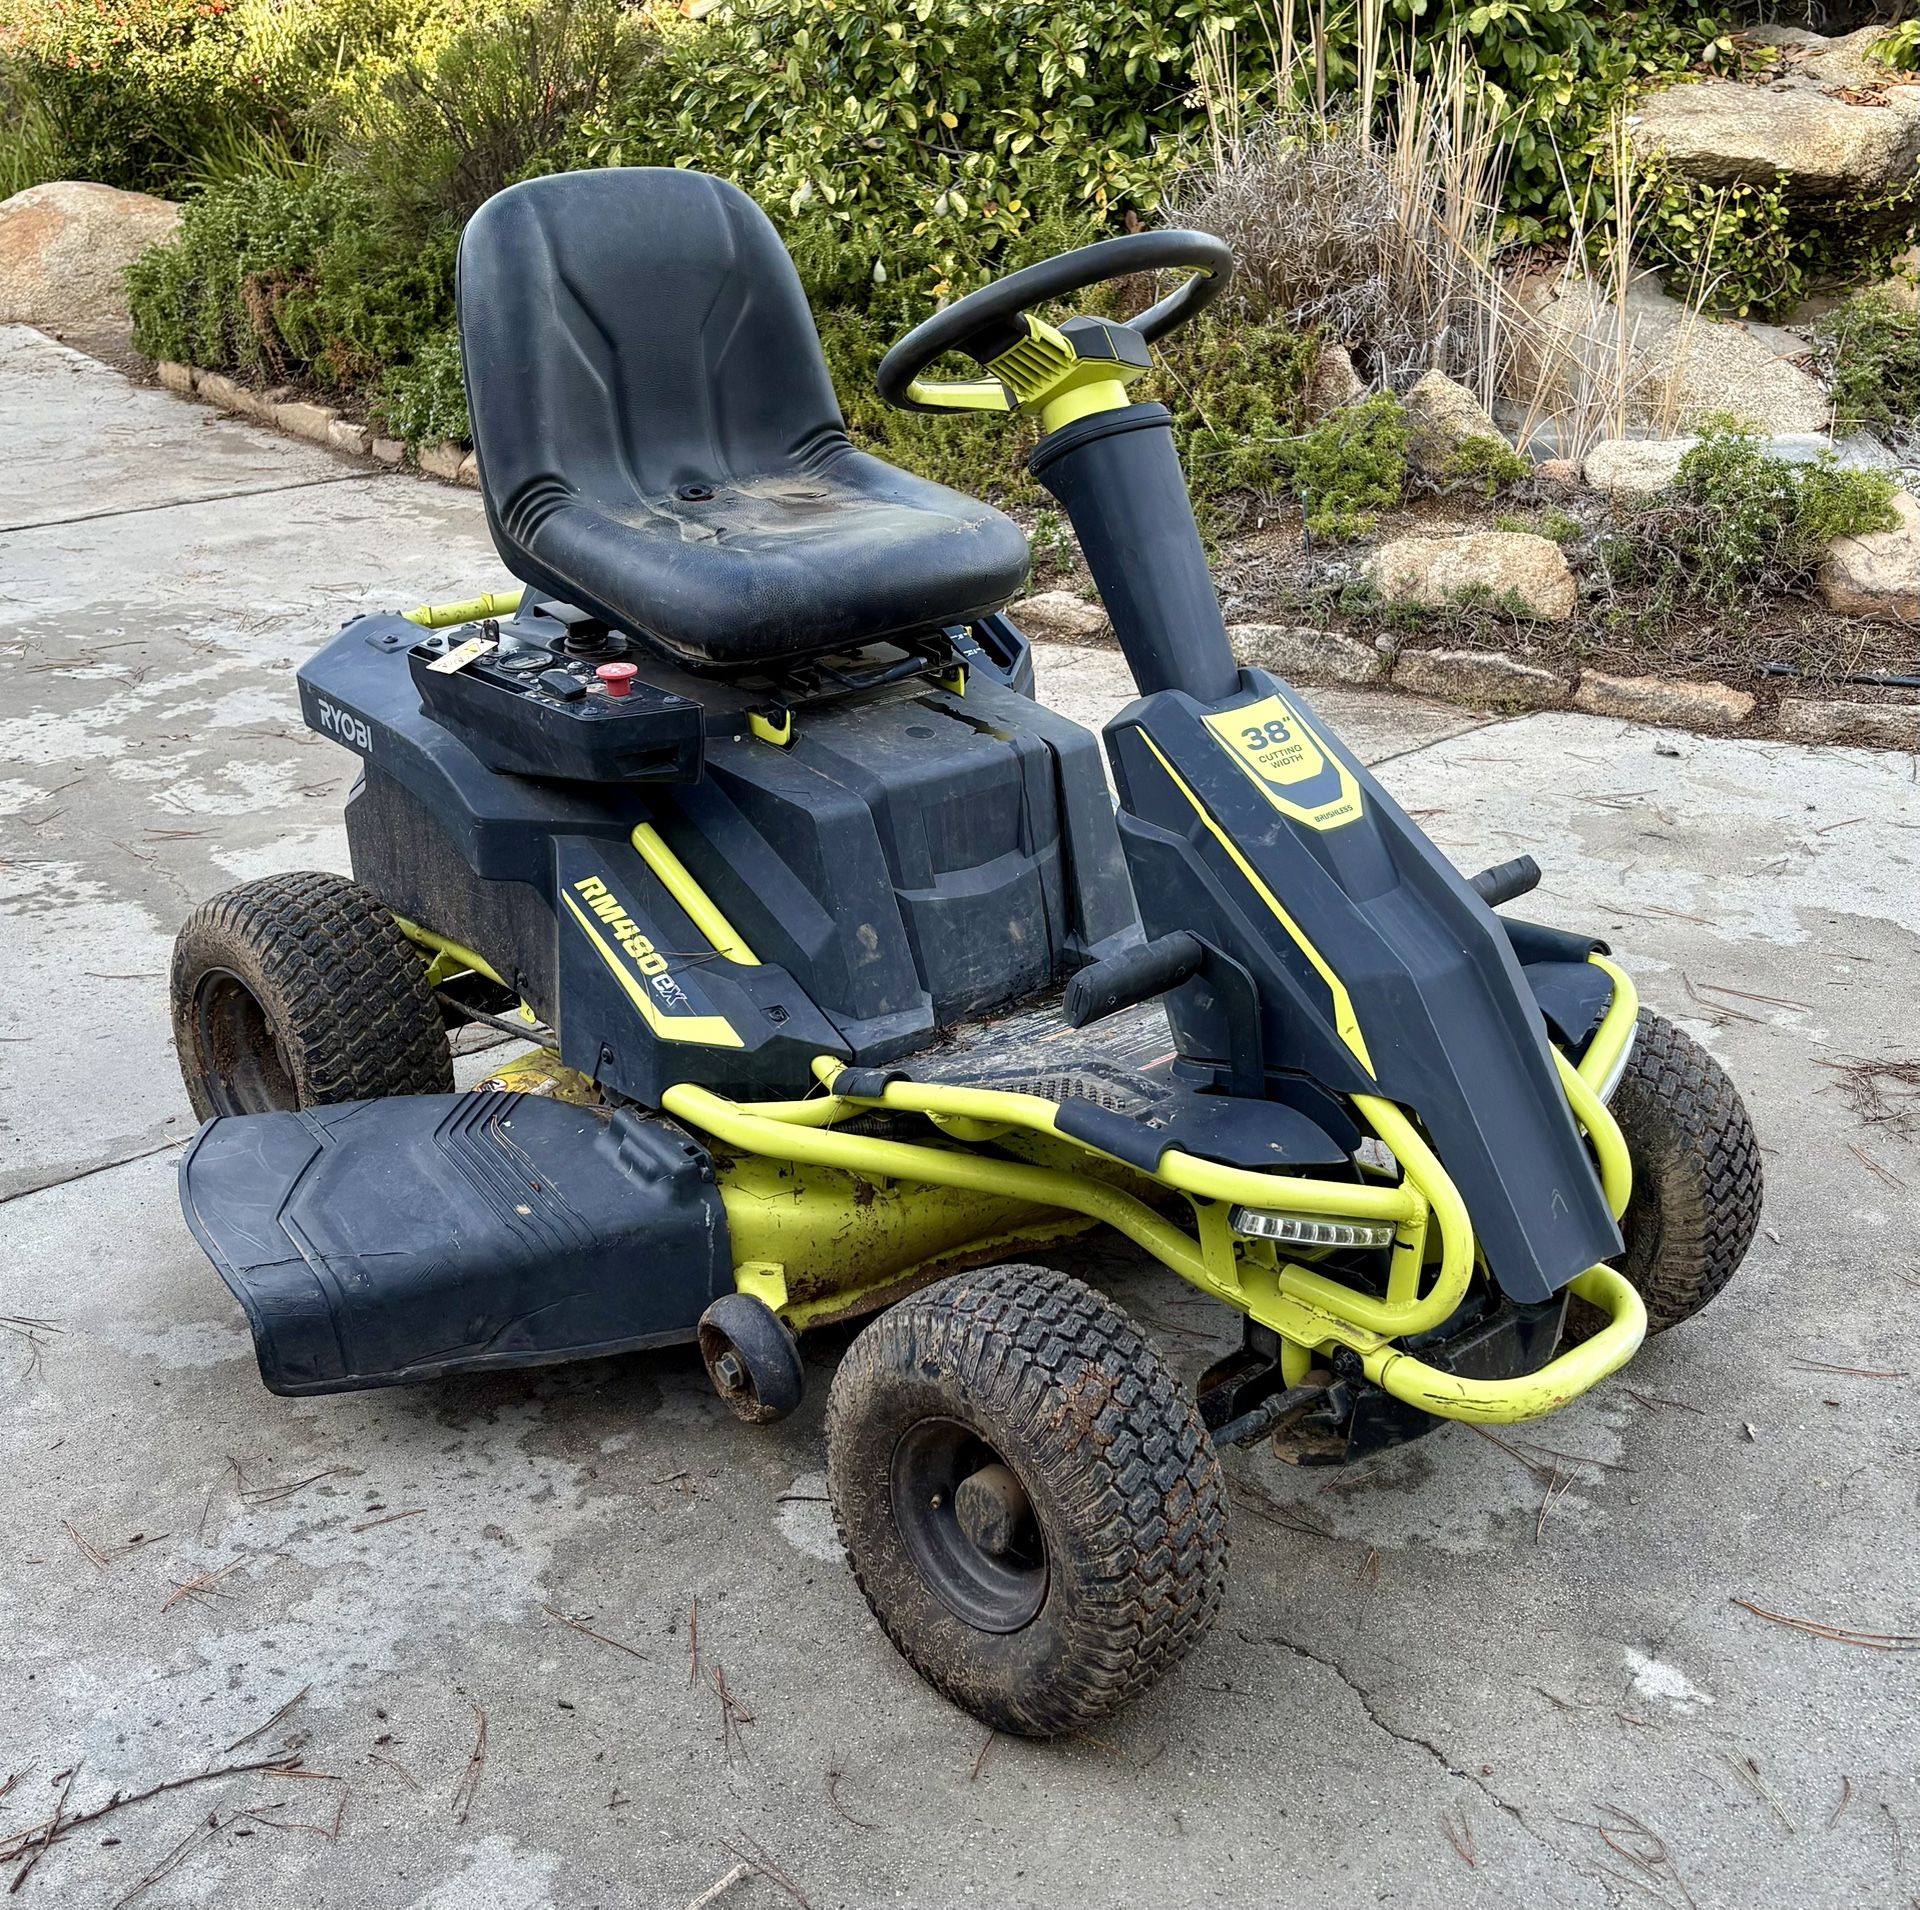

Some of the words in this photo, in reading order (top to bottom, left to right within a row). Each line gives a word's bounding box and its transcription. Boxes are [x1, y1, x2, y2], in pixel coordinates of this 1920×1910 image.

[318, 698, 373, 753] RYOBI
[1241, 716, 1291, 751] 38"
[1258, 744, 1303, 763] CUTTING
[1271, 754, 1304, 769] WIDTH
[1314, 804, 1354, 823] BRUSHLESS
